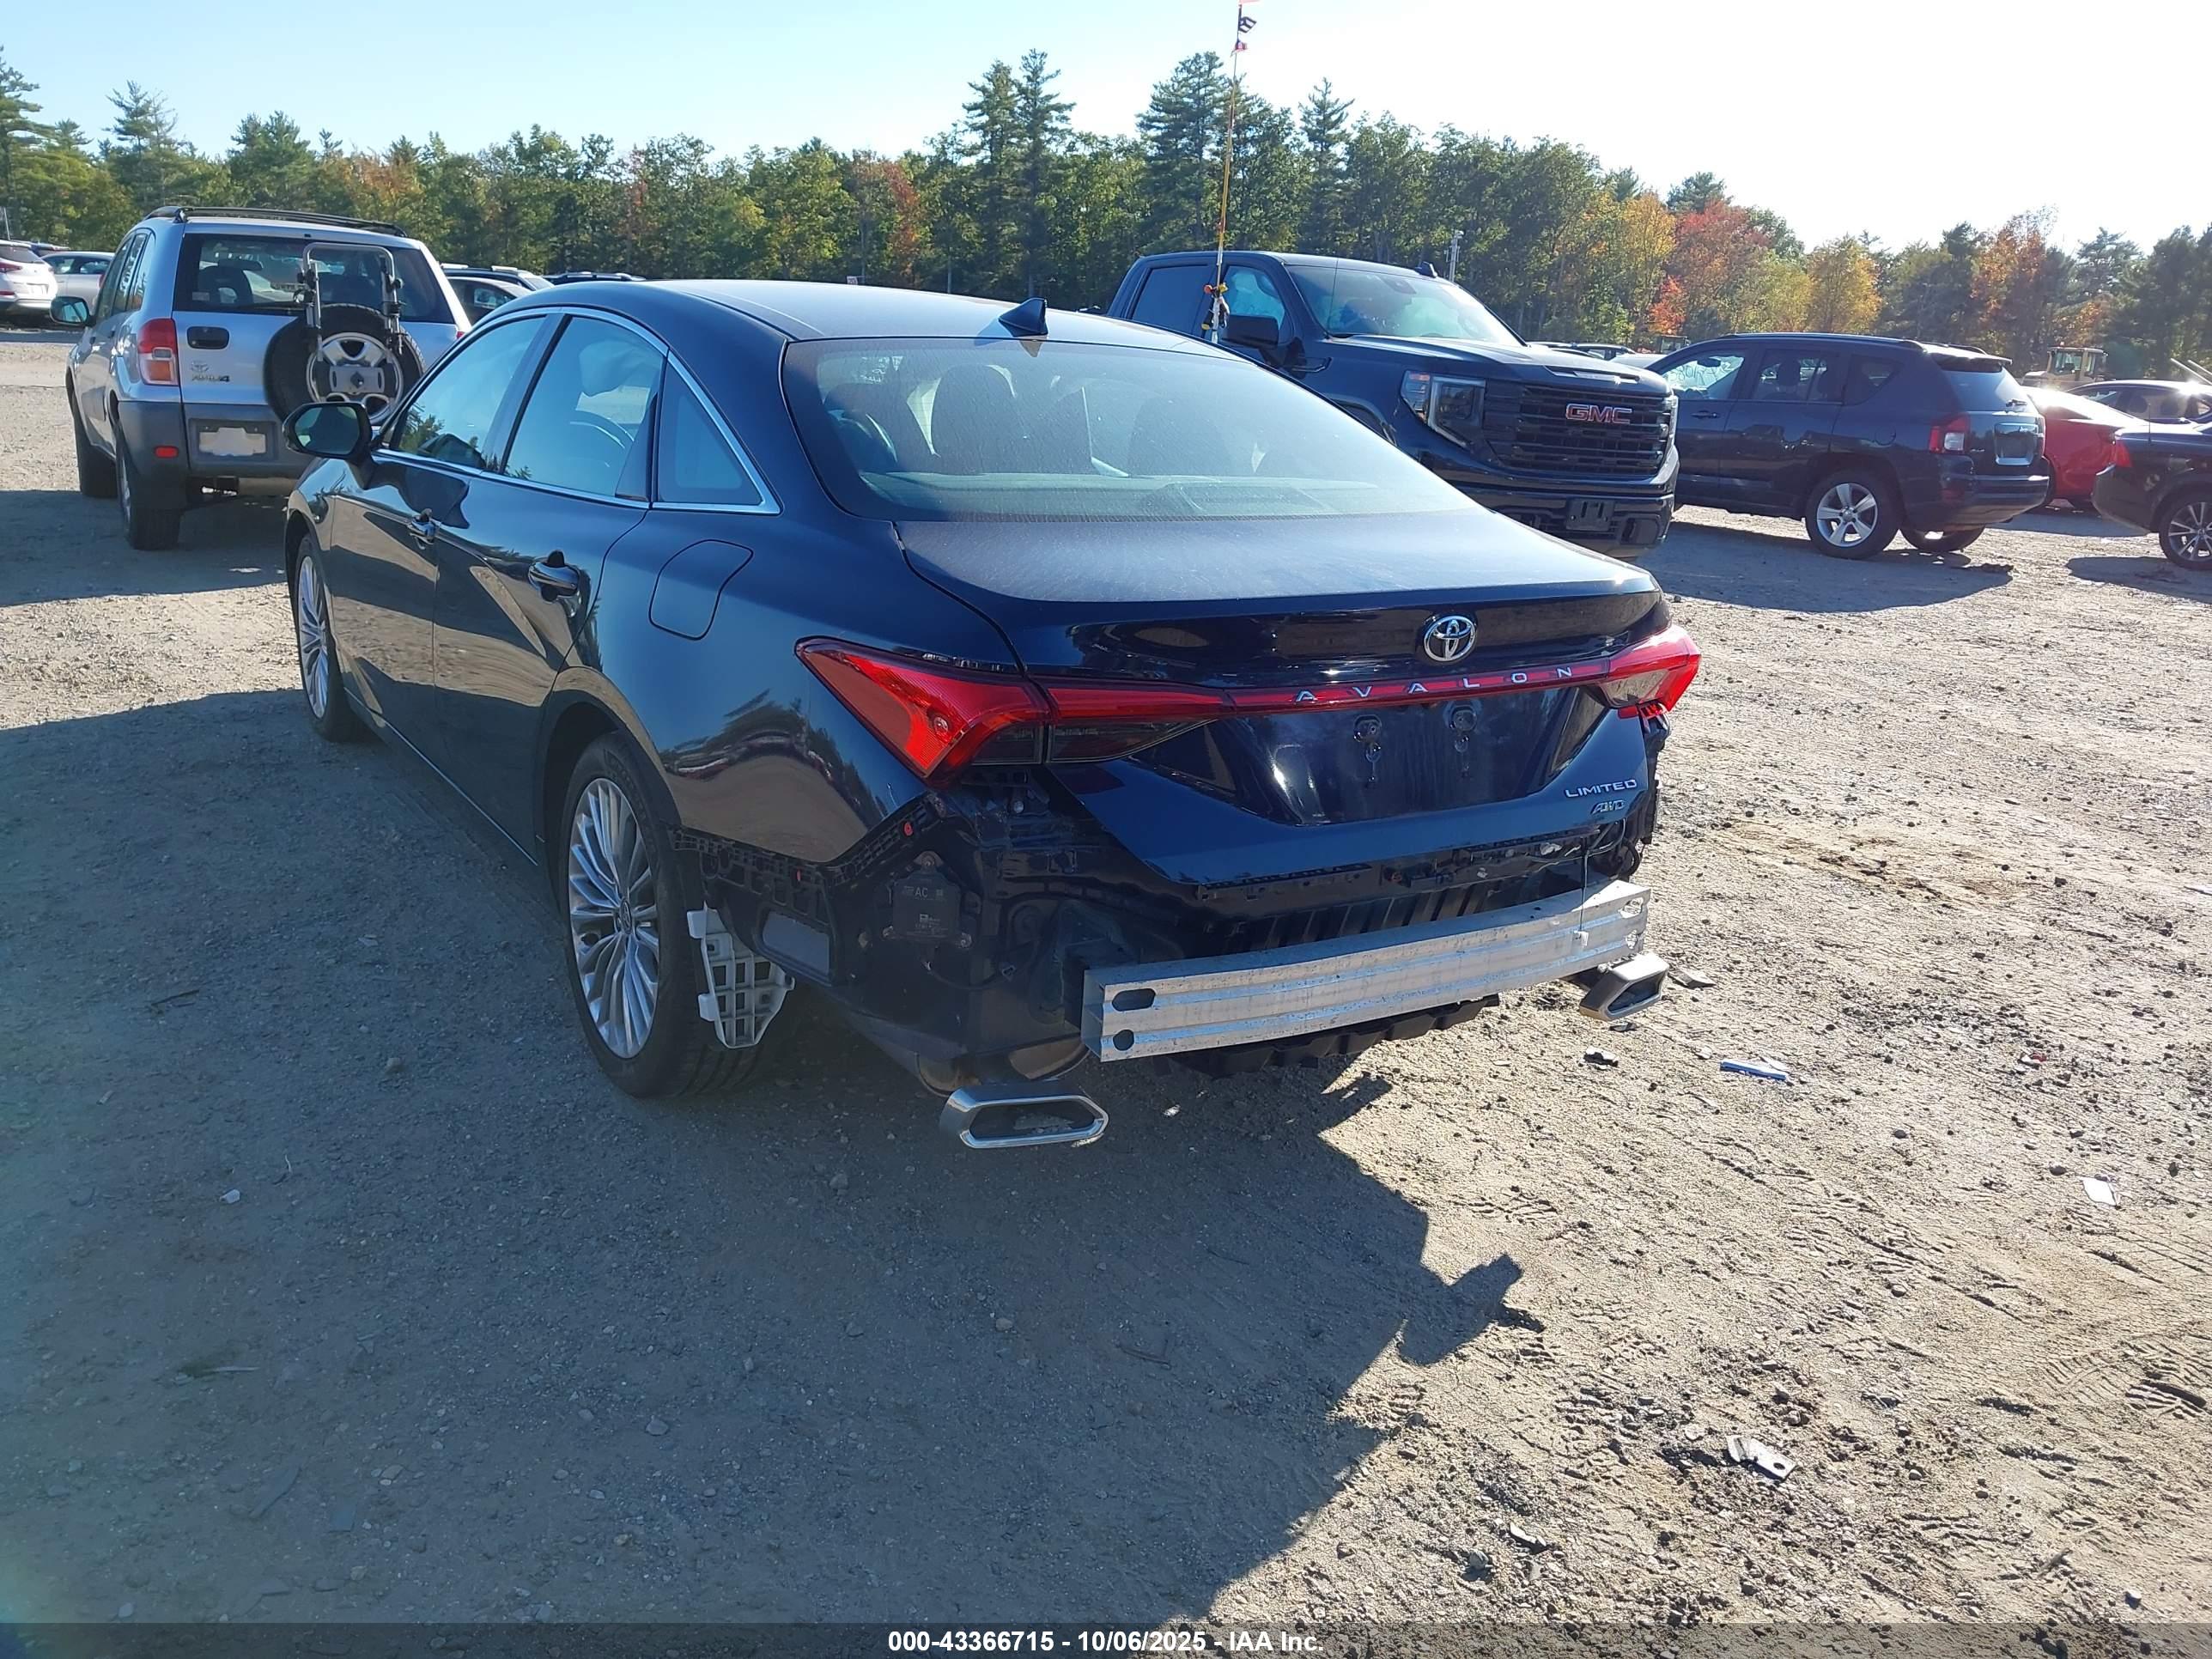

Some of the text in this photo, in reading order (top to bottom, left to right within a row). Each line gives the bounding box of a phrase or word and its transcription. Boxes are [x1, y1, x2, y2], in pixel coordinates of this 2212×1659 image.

[1565, 403, 1632, 425] GMC
[1295, 666, 1572, 702] AVALON
[1565, 779, 1638, 798] LIMITED
[1592, 799, 1627, 814] AWD
